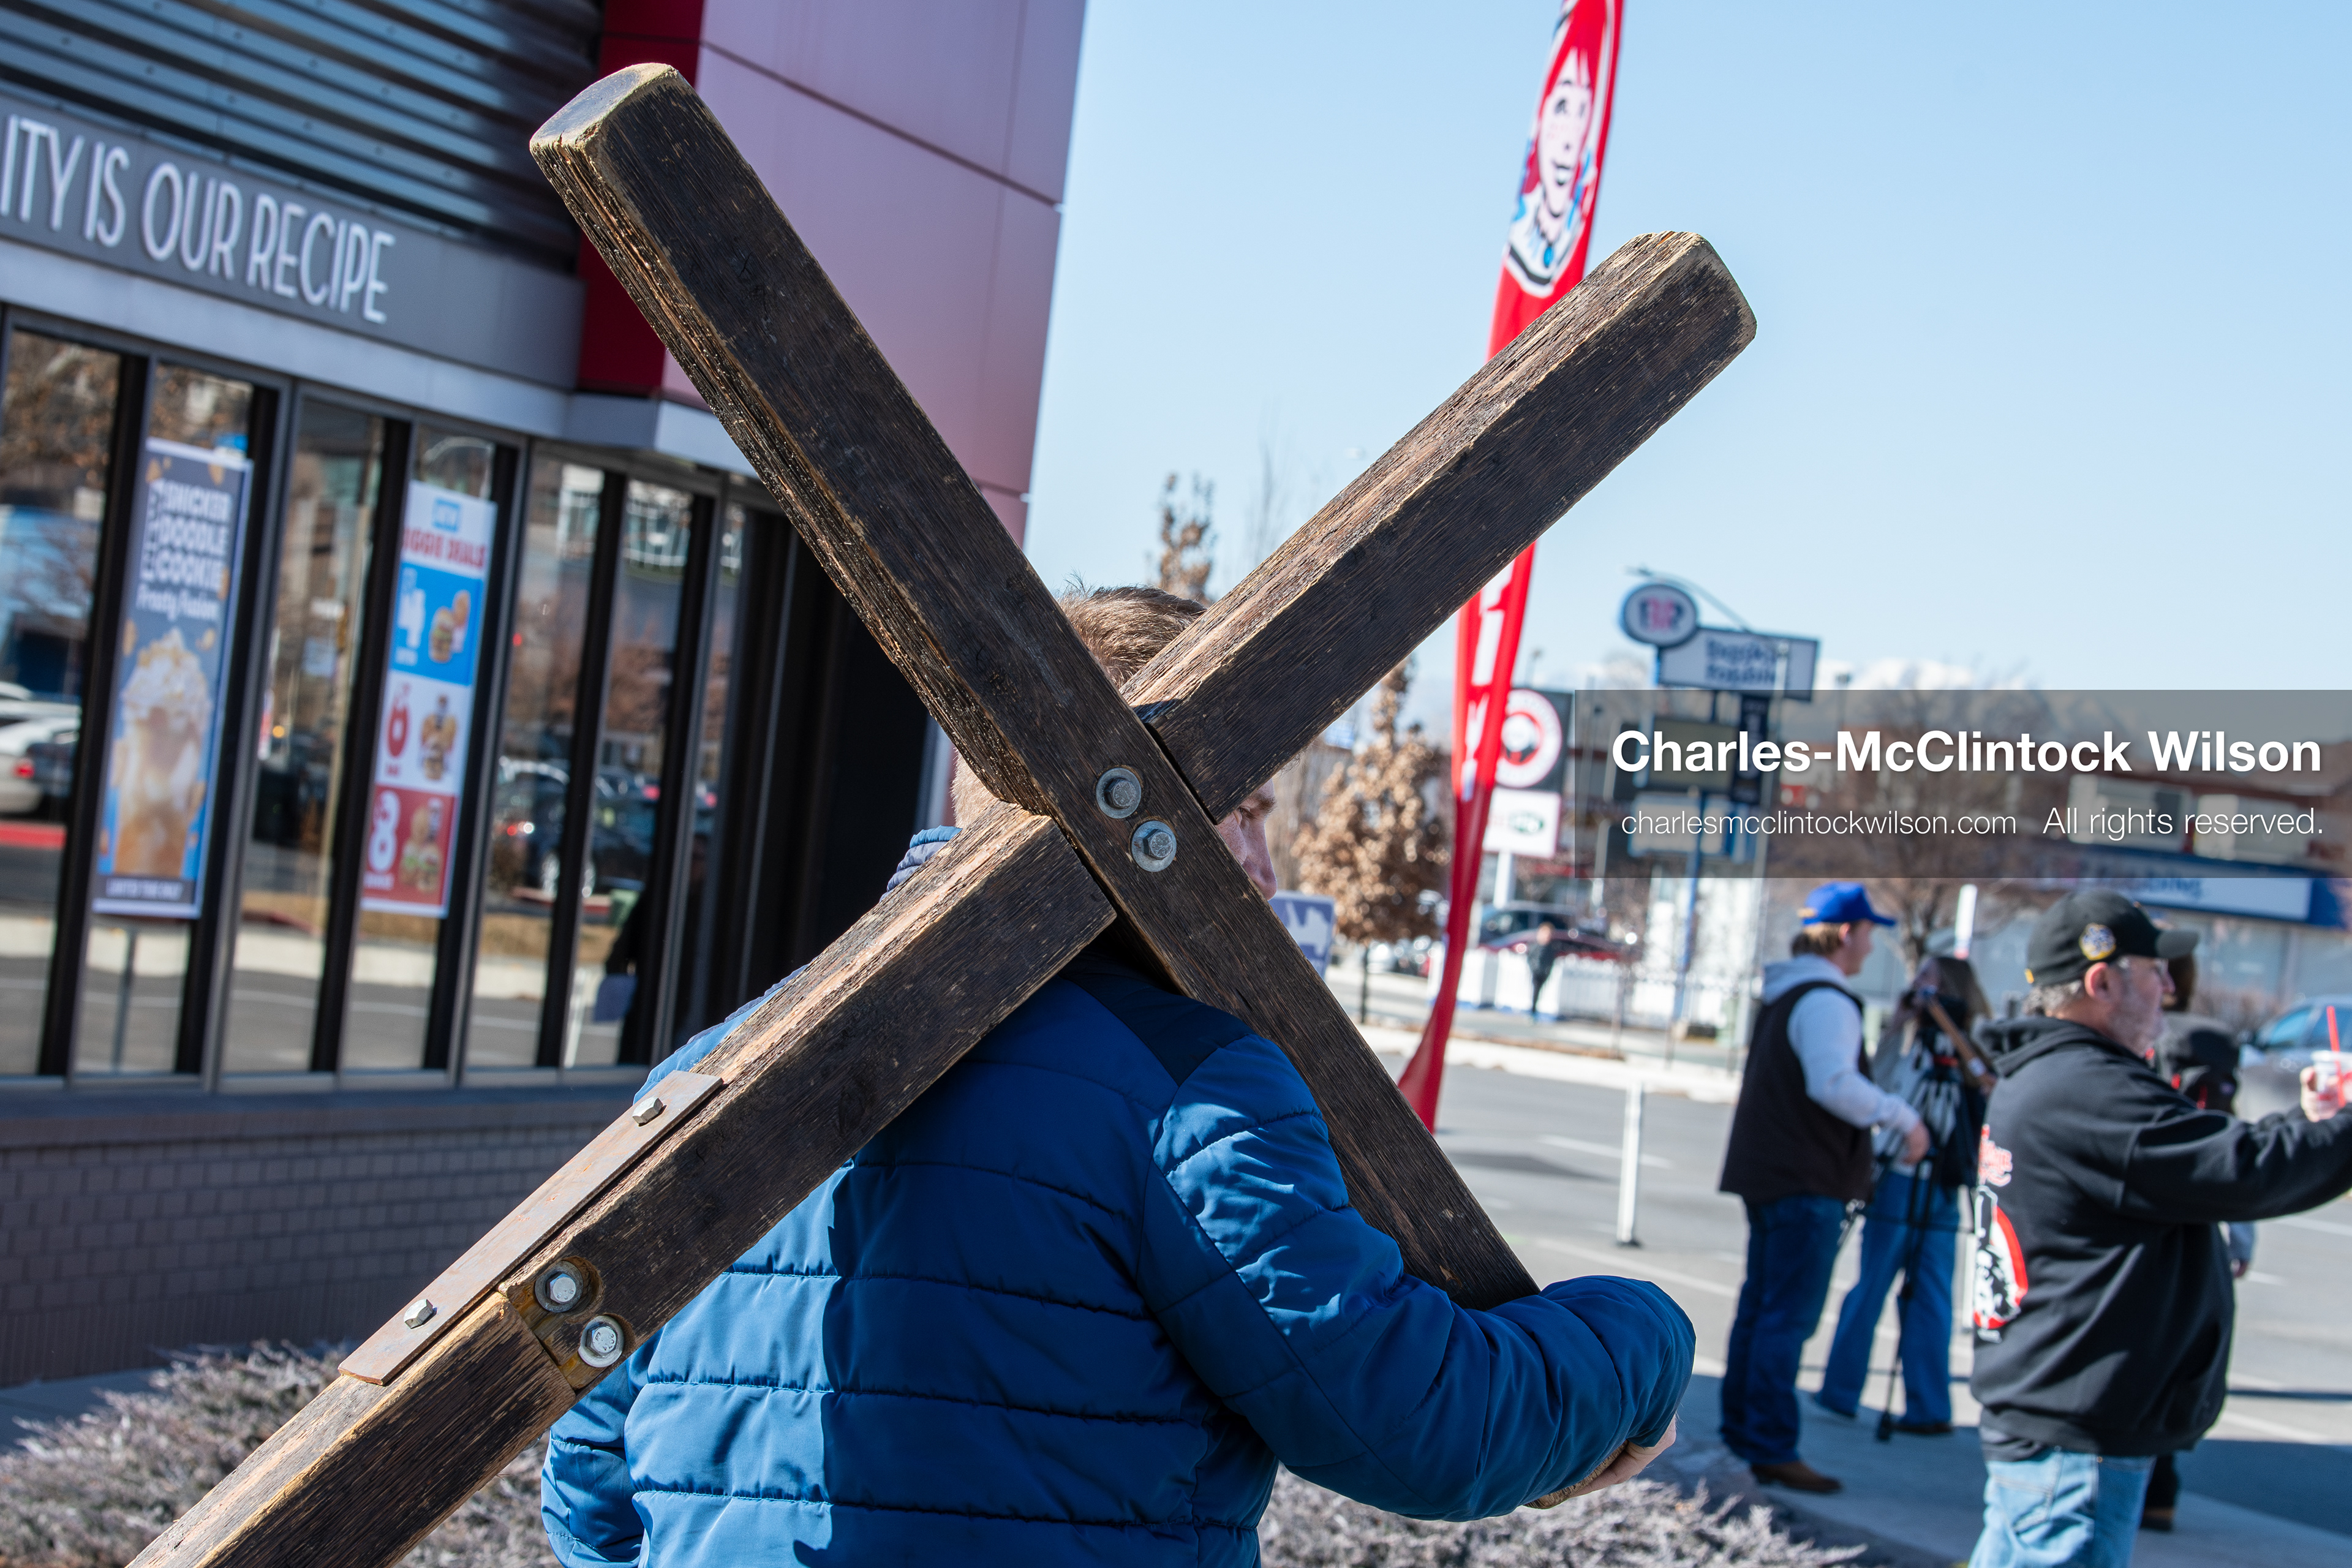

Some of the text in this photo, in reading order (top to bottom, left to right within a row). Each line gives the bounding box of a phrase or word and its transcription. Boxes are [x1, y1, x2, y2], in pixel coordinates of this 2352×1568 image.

[83, 141, 130, 247] IS
[141, 162, 243, 280] OUR
[247, 193, 396, 324] RECIPE
